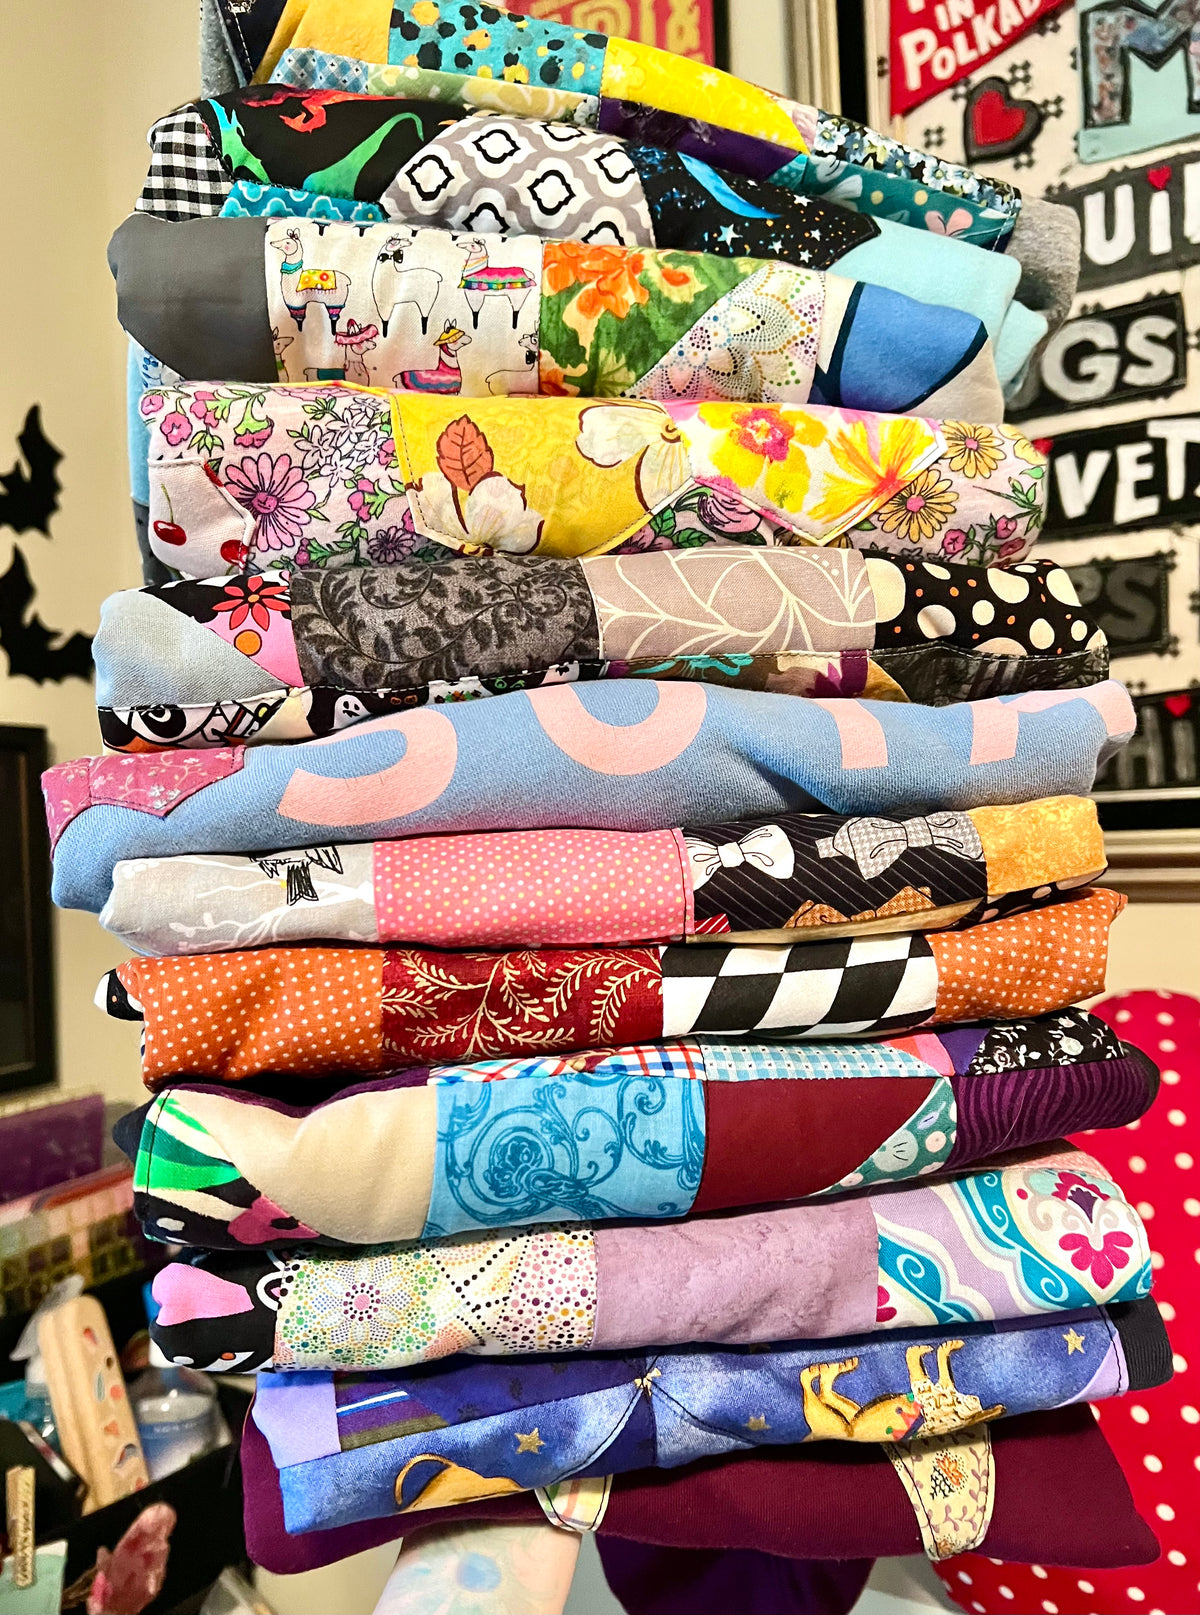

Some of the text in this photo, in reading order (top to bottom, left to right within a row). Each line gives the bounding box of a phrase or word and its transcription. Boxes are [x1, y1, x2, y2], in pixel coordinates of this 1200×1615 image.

[934, 0, 975, 31] IN
[1041, 315, 1177, 401] GS
[1054, 418, 1200, 525] VET
